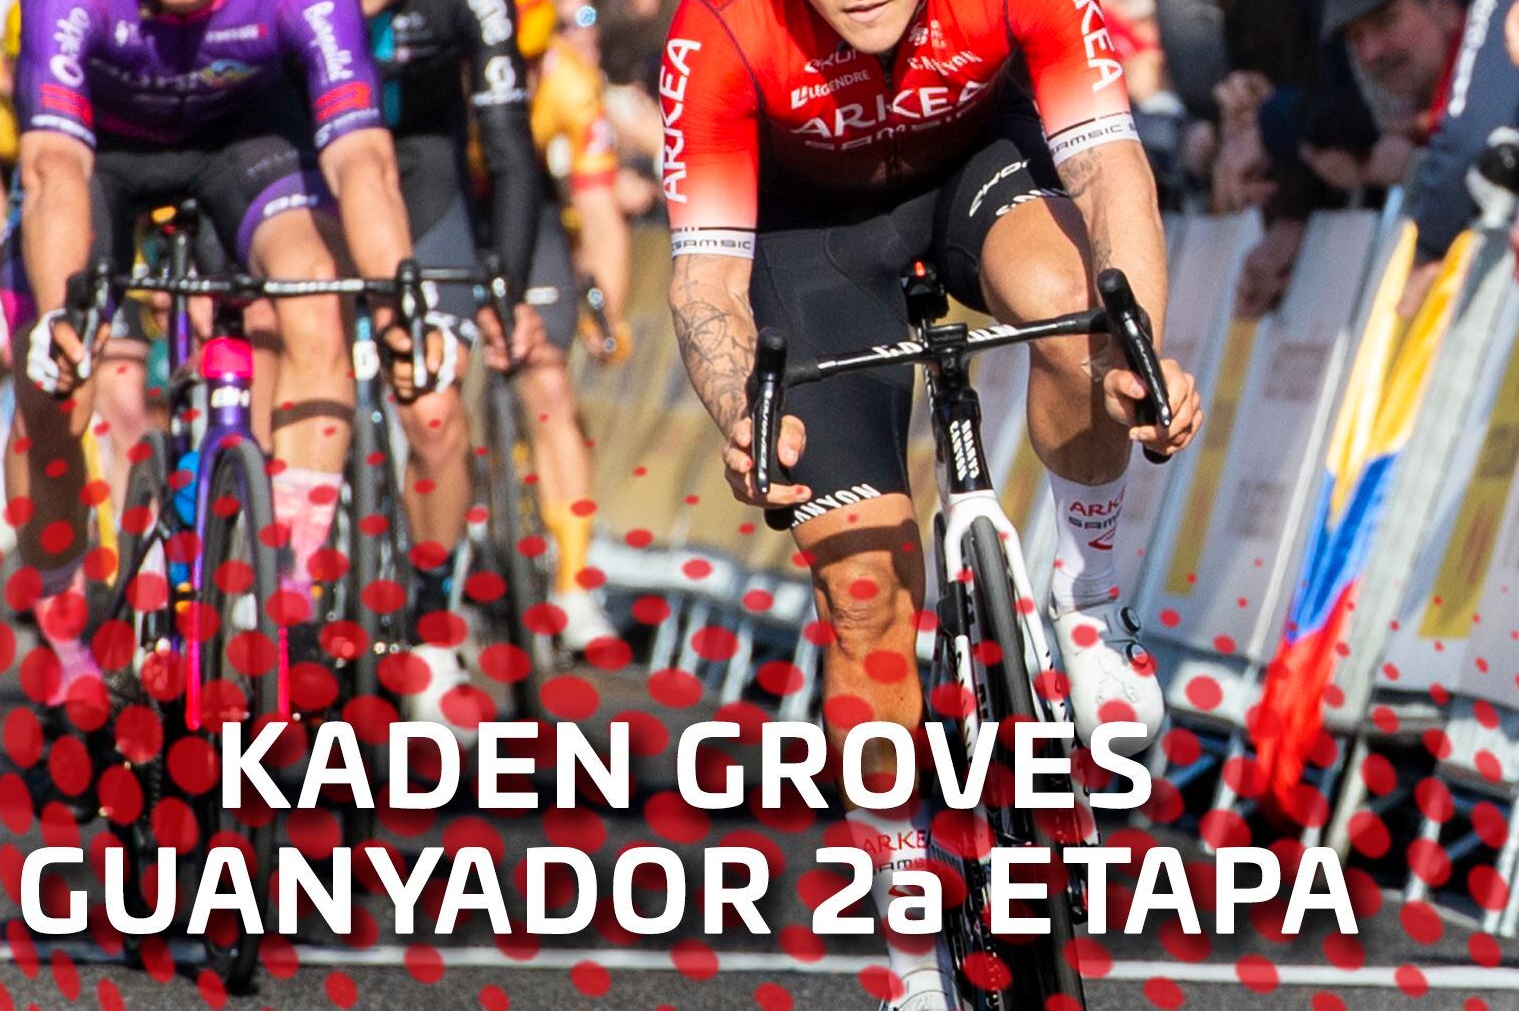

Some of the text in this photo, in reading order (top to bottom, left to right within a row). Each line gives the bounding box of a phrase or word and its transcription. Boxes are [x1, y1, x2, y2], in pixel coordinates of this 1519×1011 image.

[790, 79, 991, 138] ARKEA
[808, 69, 871, 100] LEGENDRE
[659, 38, 703, 204] ARKEA
[949, 420, 968, 483] CANYON
[961, 419, 980, 480] CANYON
[791, 484, 881, 529] ANYON
[1069, 487, 1126, 517] ARK
[863, 829, 928, 855] ARKE
